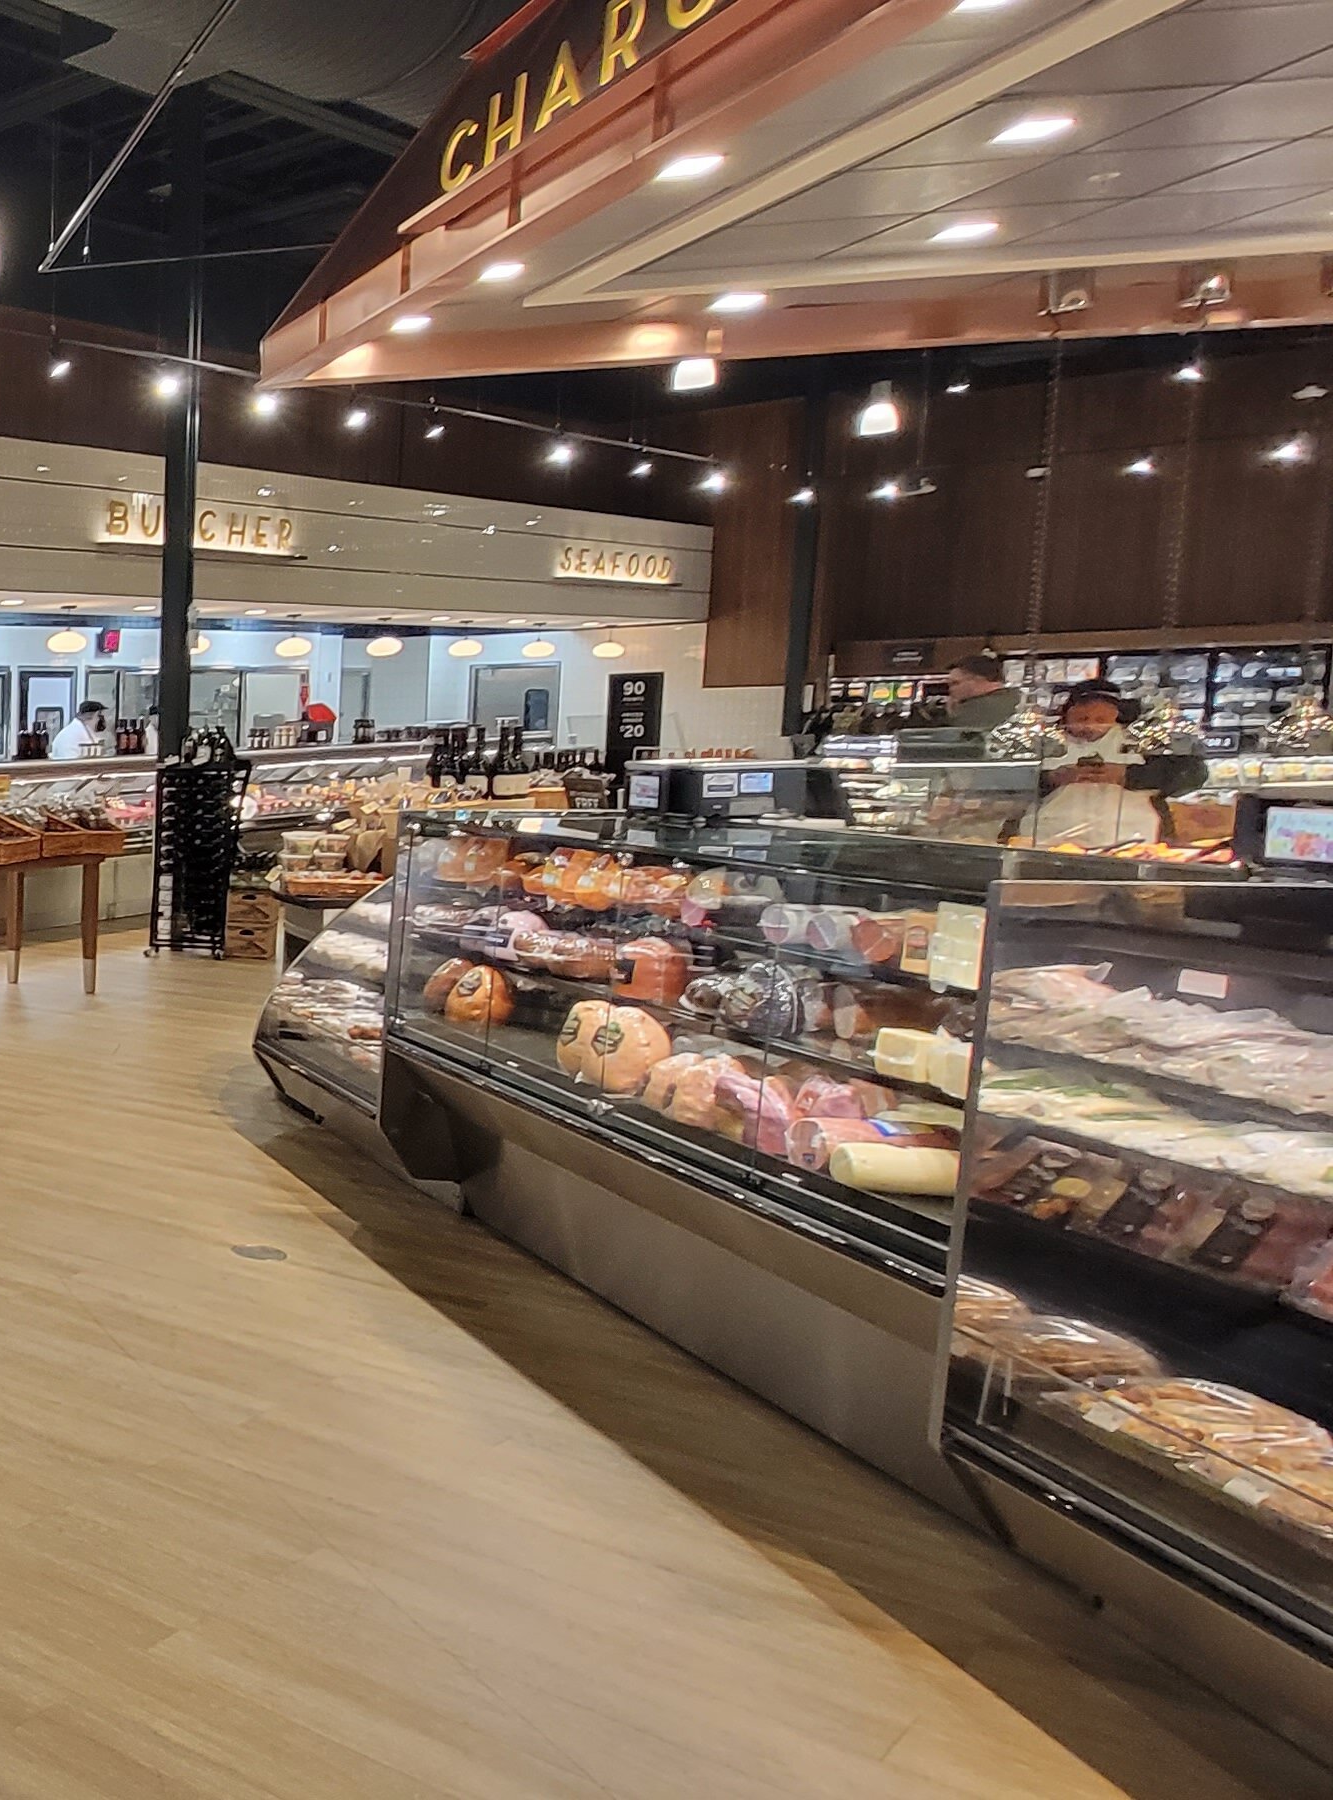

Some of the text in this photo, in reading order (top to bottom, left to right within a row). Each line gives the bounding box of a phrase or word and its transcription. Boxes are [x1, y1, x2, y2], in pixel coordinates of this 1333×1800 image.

[107, 500, 293, 549] BUCHER
[560, 547, 672, 579] SEAFOOD
[623, 681, 646, 696] 90
[619, 724, 645, 738] $20
